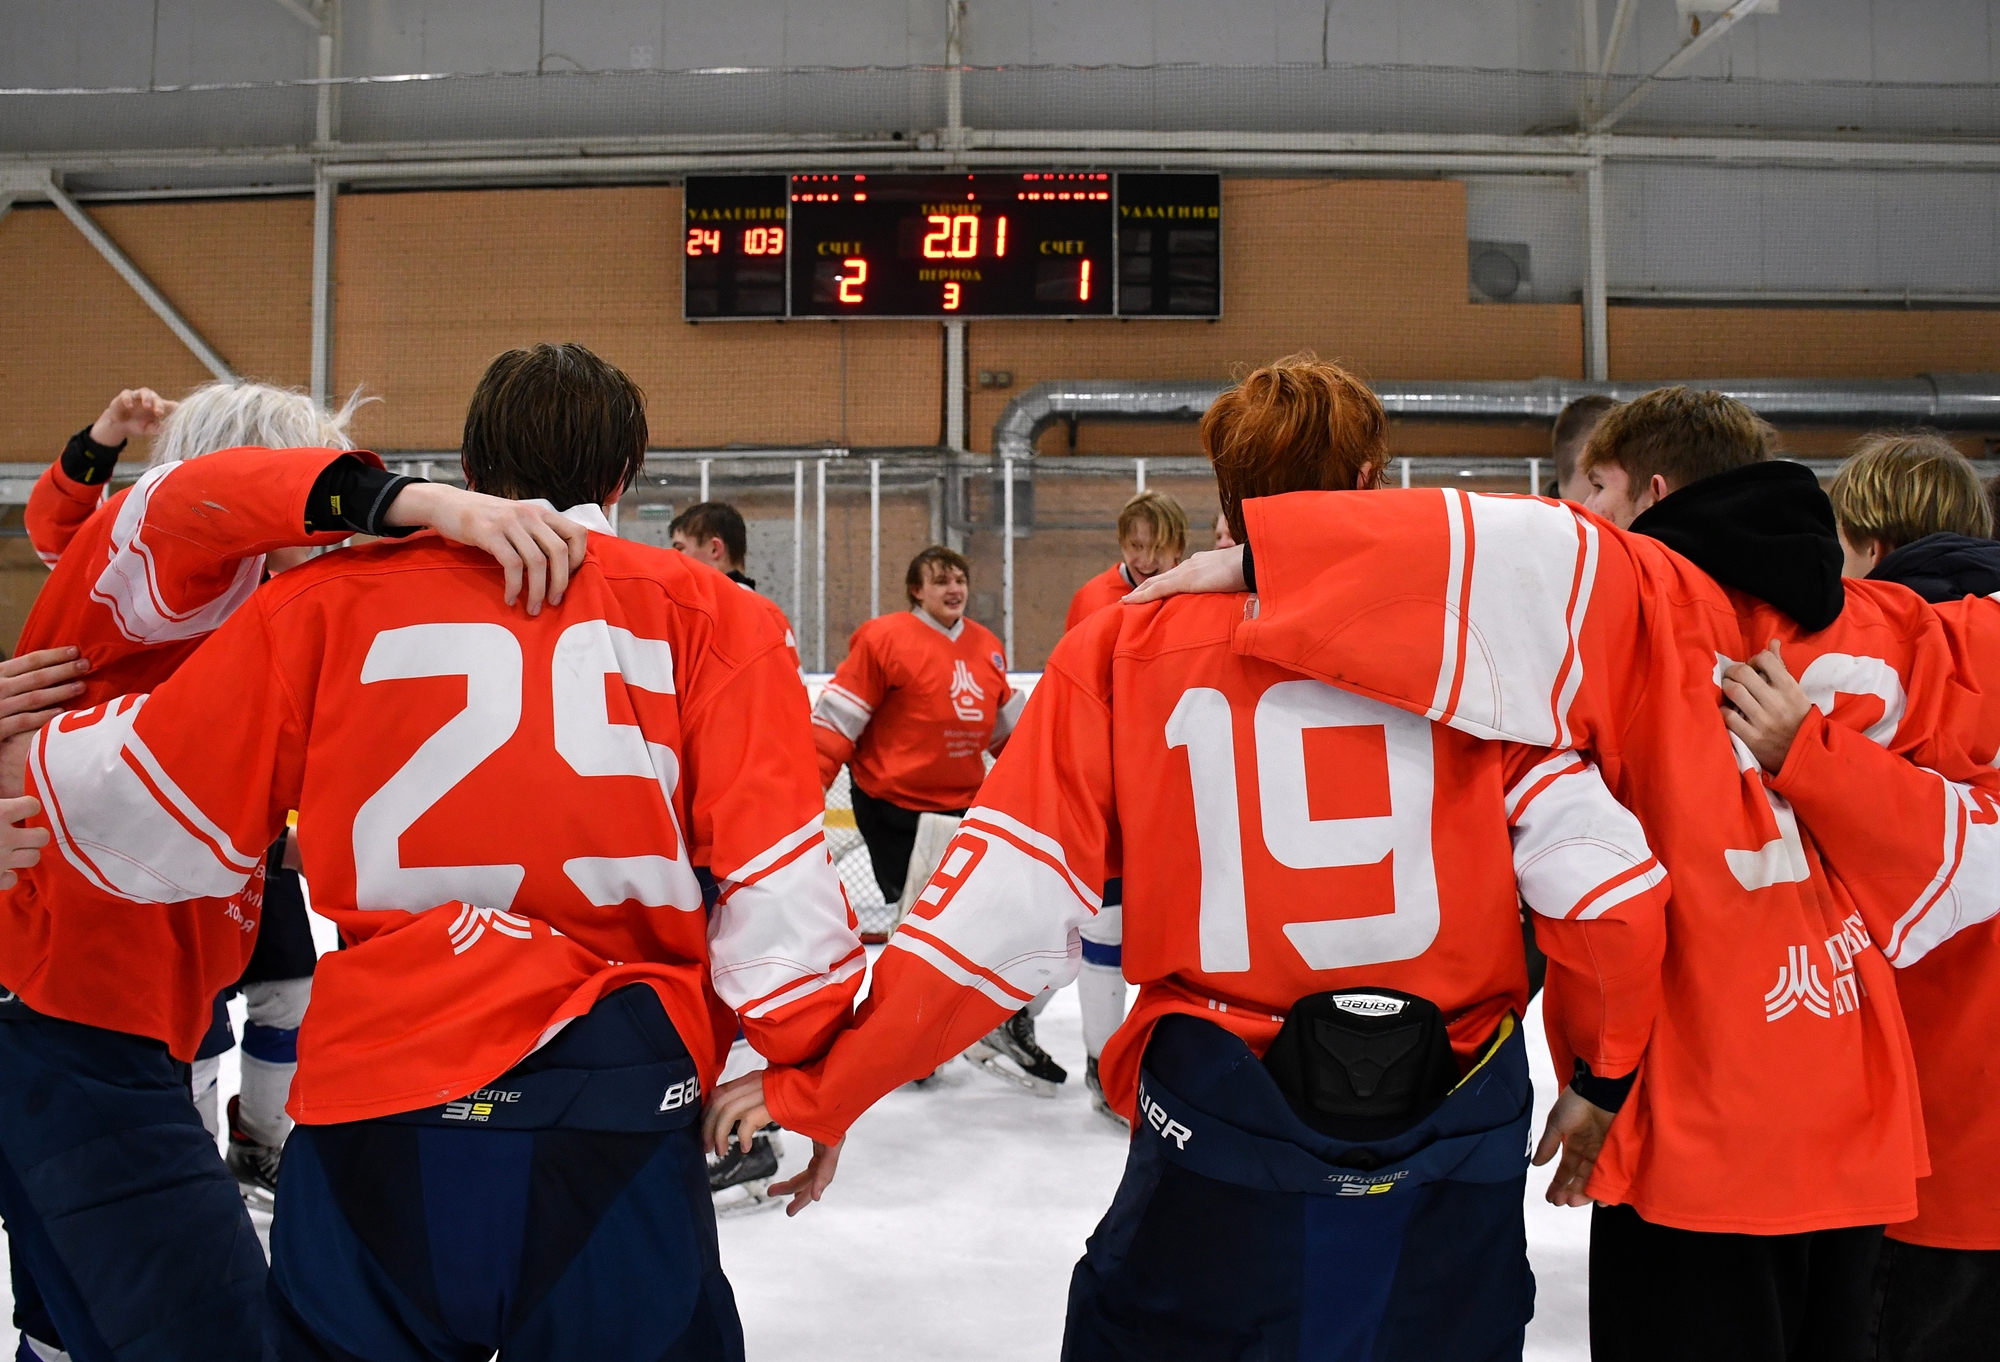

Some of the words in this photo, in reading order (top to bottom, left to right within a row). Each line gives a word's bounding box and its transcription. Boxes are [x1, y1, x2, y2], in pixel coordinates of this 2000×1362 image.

[688, 207, 785, 219] УДАЛЕНИЯ
[1120, 206, 1219, 218] УДАЛЕНИЯ
[687, 229, 720, 255] 24
[817, 241, 861, 255] СЧЕТ
[1040, 241, 1084, 255] СЧЕТ
[839, 259, 867, 302] 2
[919, 269, 982, 281] ПЕРИОД
[1079, 259, 1090, 300] 1
[943, 282, 960, 309] 3
[352, 619, 702, 912] 25
[1164, 680, 1440, 973] 19
[1340, 999, 1397, 1011] BAUER
[468, 1114, 490, 1122] PRO
